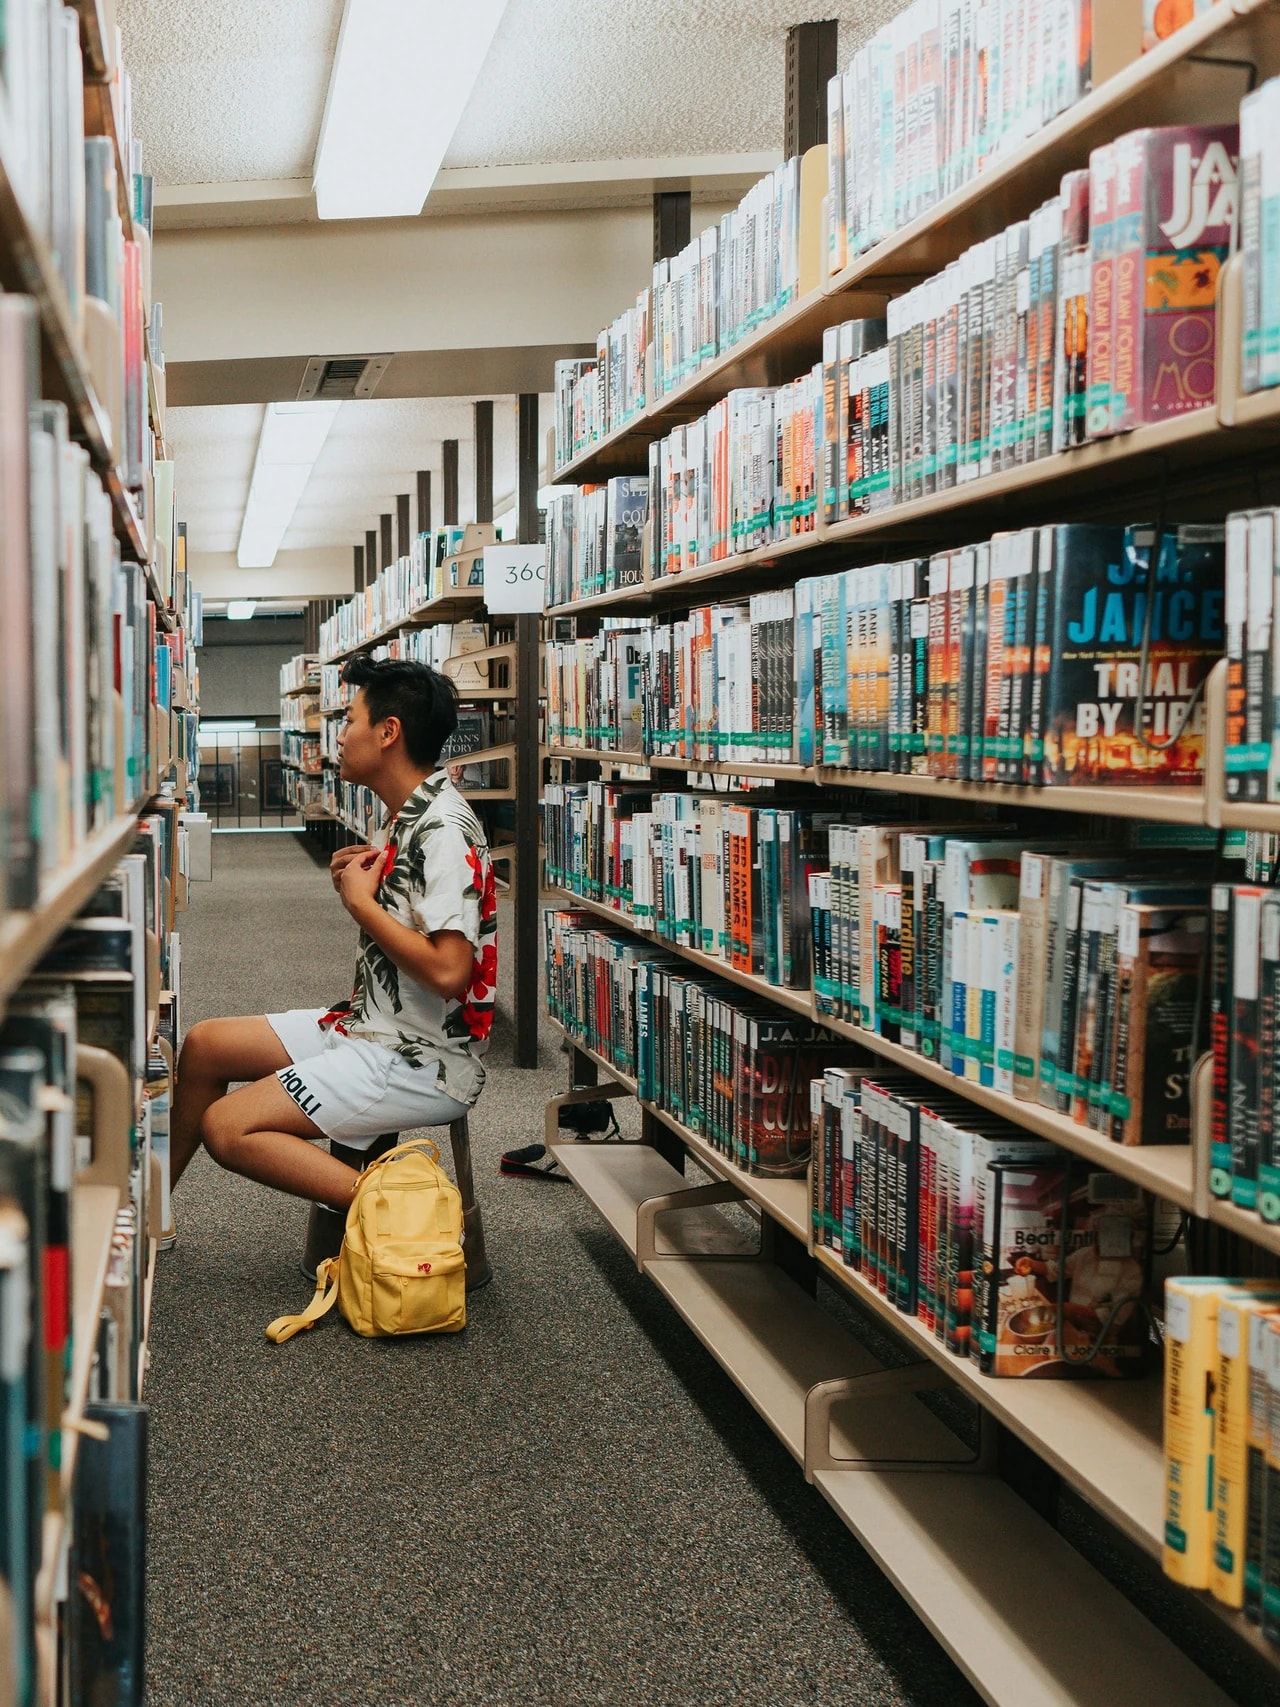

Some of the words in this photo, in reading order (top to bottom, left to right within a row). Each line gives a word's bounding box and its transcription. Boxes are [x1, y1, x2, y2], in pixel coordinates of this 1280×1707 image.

[968, 288, 982, 336] JANCE
[950, 597, 960, 644] JANCE
[987, 602, 1003, 665] TOMBSTONE
[1067, 584, 1224, 647] JANCE
[822, 649, 834, 688] CRIME
[916, 638, 925, 660] SNAKE
[889, 655, 899, 700] QUEEN
[901, 653, 912, 700] QUEEN
[916, 662, 925, 694] CROSSING
[987, 669, 1003, 718] COURAGE
[1093, 662, 1195, 698] TRIAL
[1076, 702, 1123, 737] BY
[831, 924, 839, 944] WEB
[850, 930, 859, 949] WEB
[901, 898, 915, 976] Jardine
[927, 897, 937, 945] QUINTIN
[927, 947, 937, 991] JARDINE
[1046, 920, 1059, 983] Partners
[1062, 950, 1075, 1001] Jeffries
[639, 1000, 648, 1038] JAMES
[761, 1027, 799, 1042] J.A.
[984, 1005, 992, 1043] KILLINGS
[1232, 1079, 1247, 1169] ANALYST
[878, 1170, 886, 1212] NAKED
[887, 1154, 897, 1196] NIGHT
[898, 1161, 907, 1205] NIGHT
[887, 1198, 896, 1243] WATCH
[897, 1206, 906, 1251] WATCH
[1014, 1231, 1056, 1246] Beat
[1013, 1344, 1050, 1356] Claire
[1169, 1339, 1183, 1416] Kellerman
[1218, 1356, 1231, 1434] Kellerman
